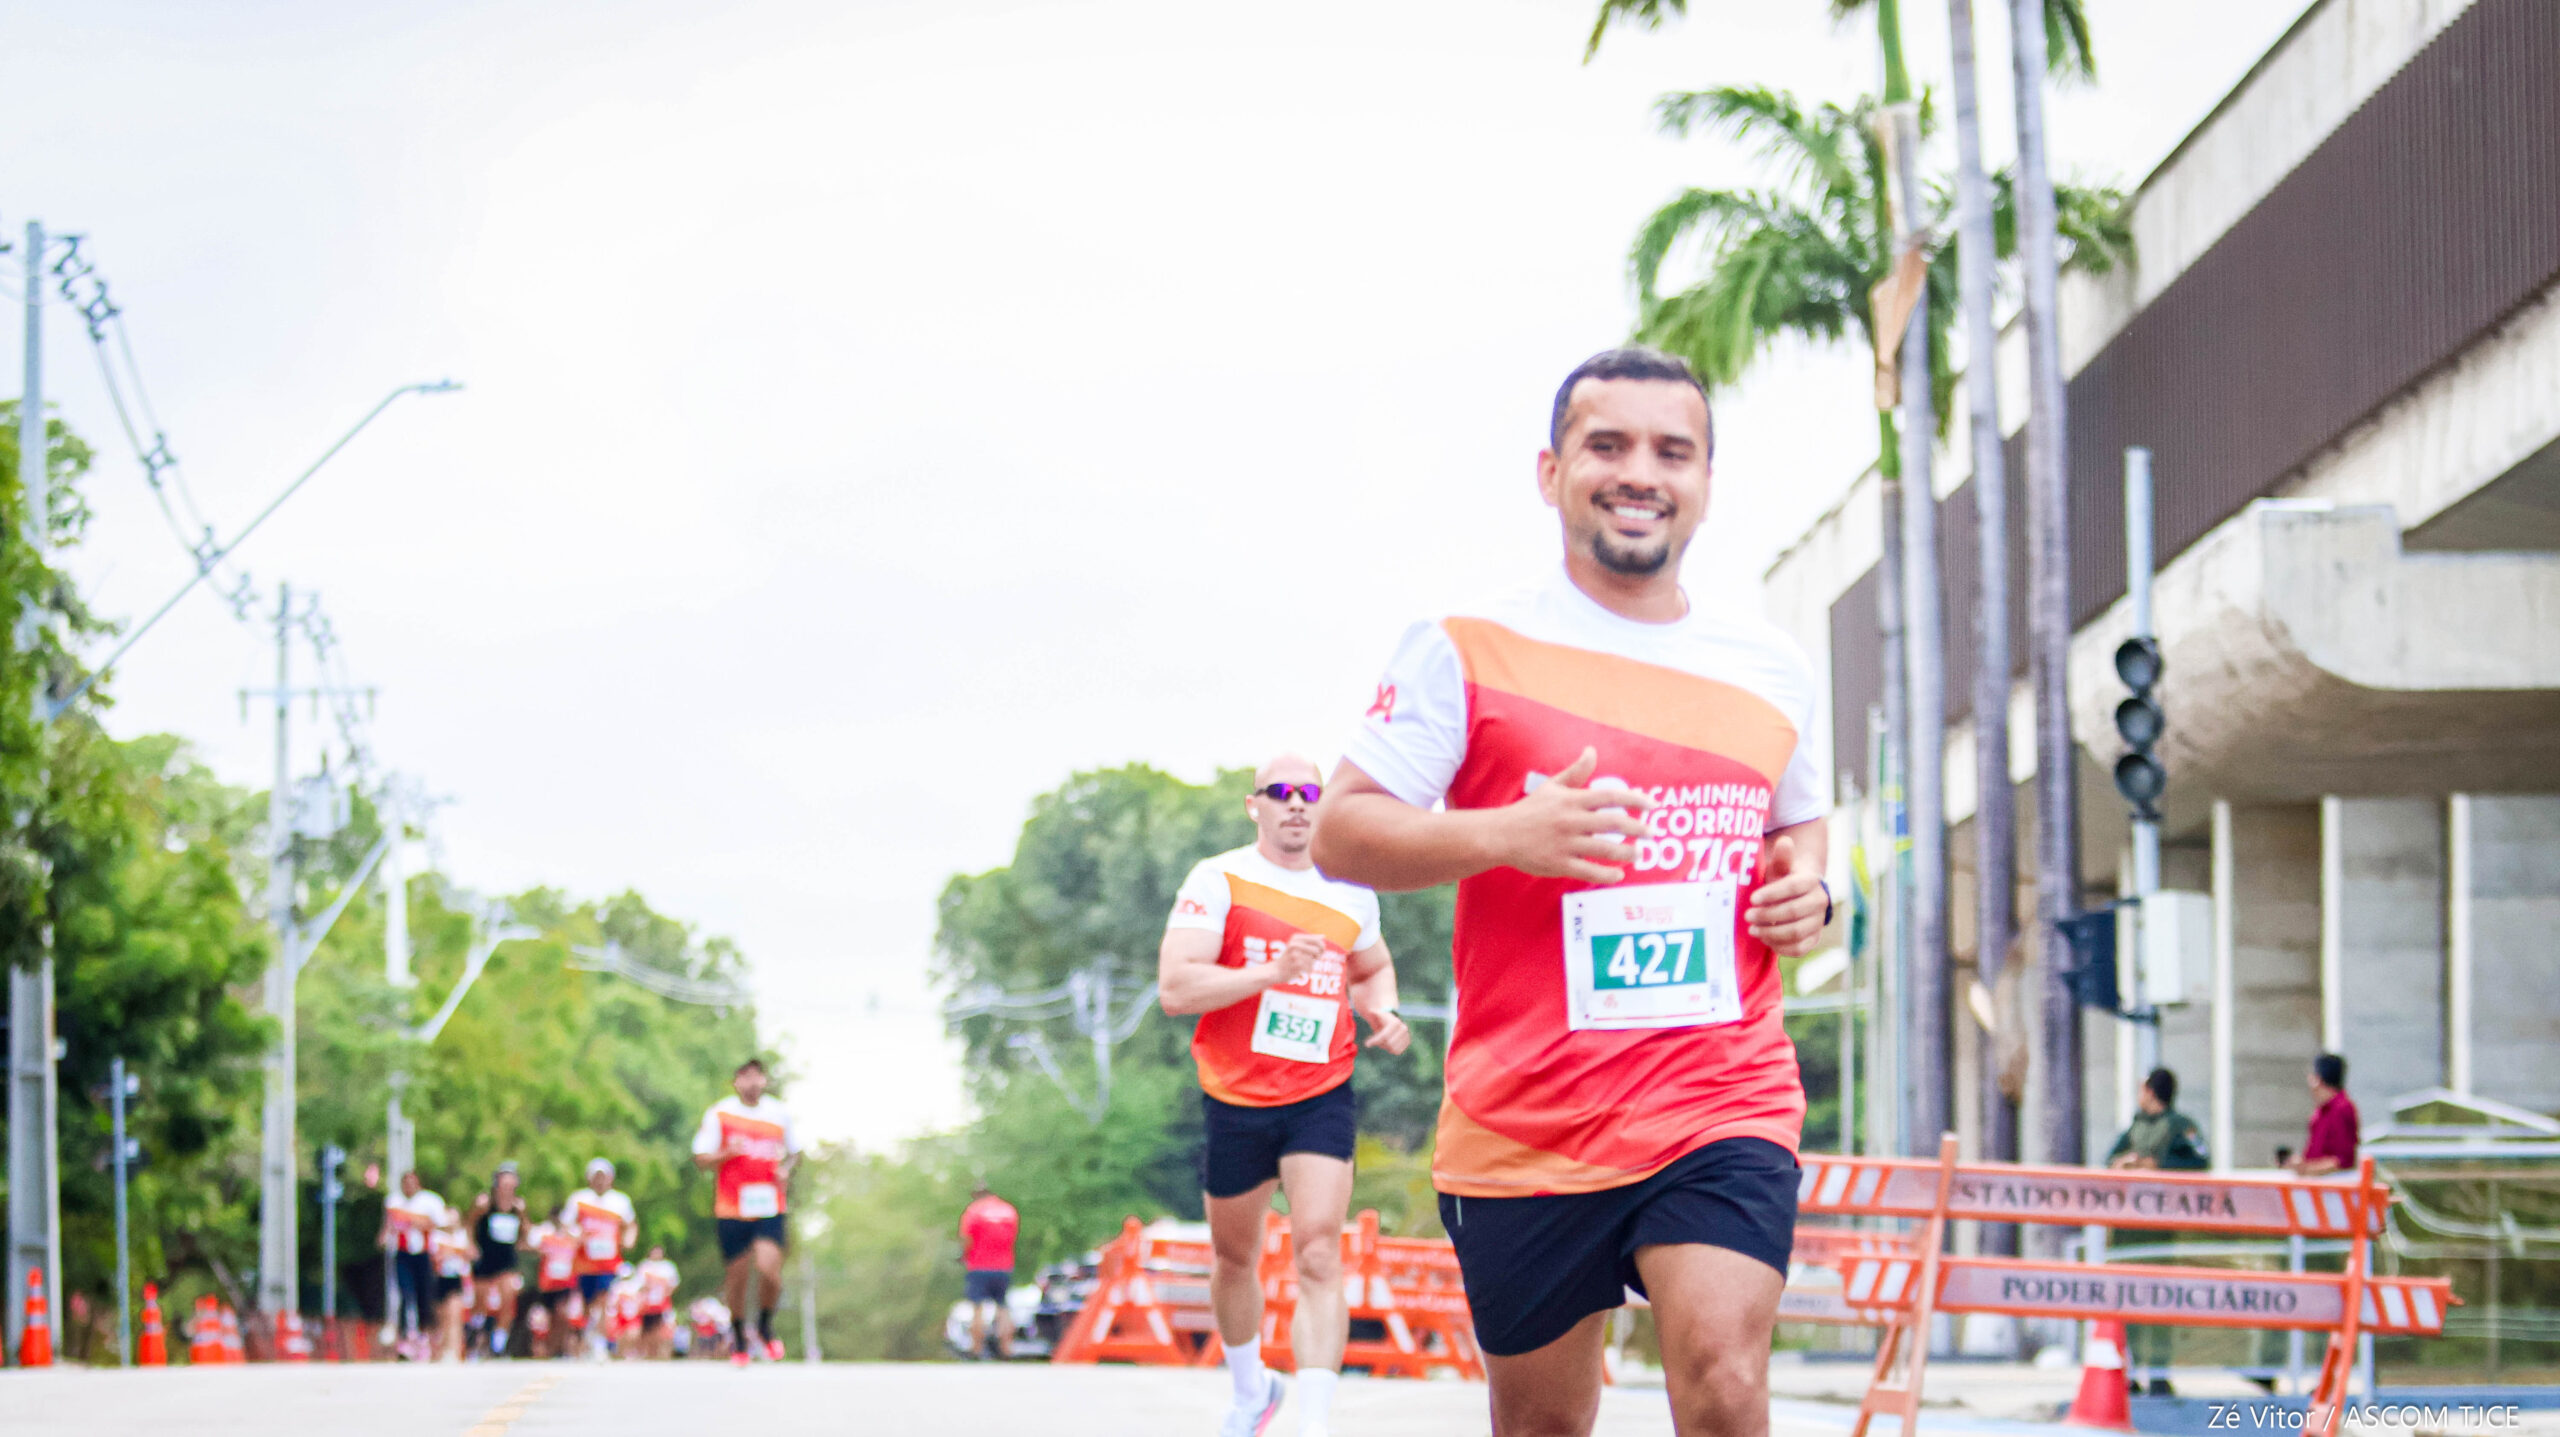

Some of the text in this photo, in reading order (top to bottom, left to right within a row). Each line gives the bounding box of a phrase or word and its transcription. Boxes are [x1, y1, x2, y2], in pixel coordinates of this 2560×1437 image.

[1633, 837, 1759, 886] DO TJCE
[1607, 931, 1694, 986] 427
[1273, 1013, 1317, 1042] 359
[2079, 1187, 2127, 1213] DO
[2002, 1276, 2298, 1315] PODER JUDICIÁRIO
